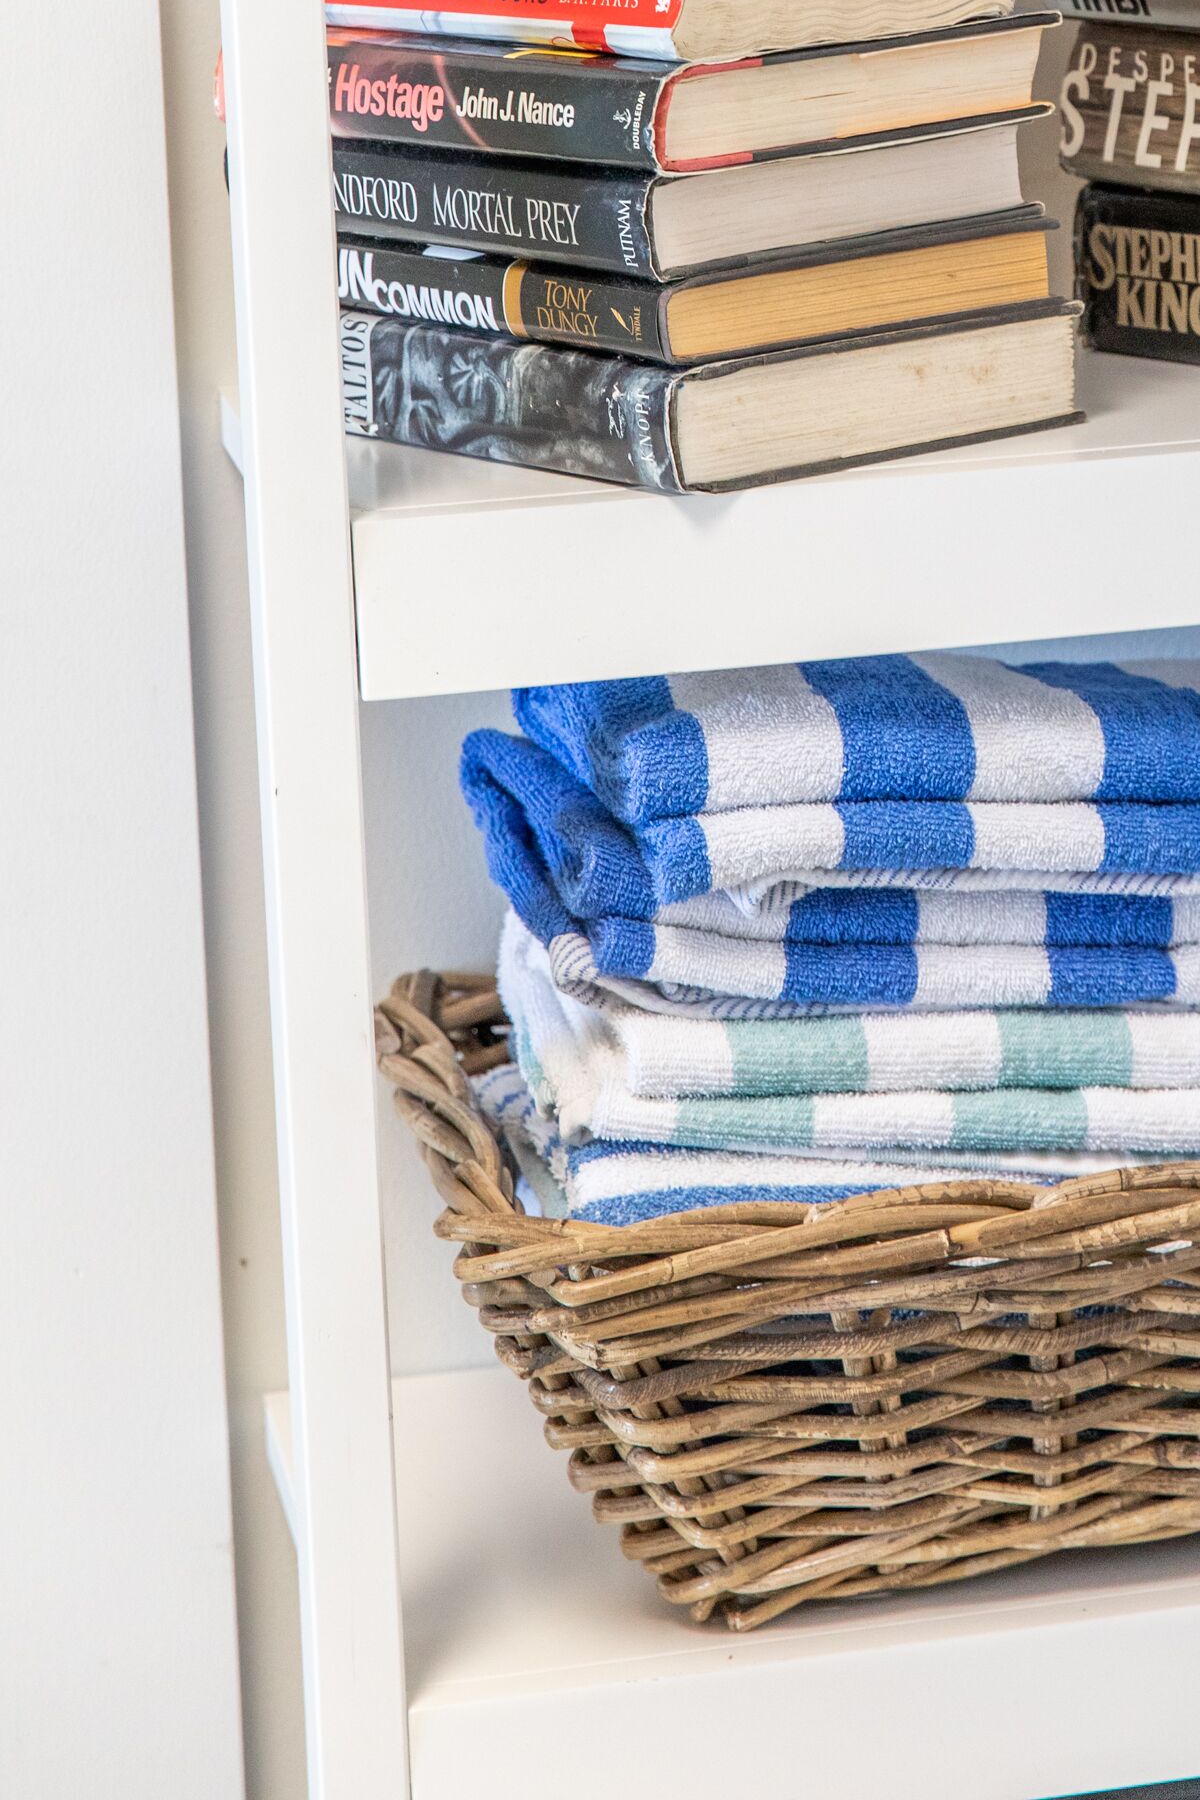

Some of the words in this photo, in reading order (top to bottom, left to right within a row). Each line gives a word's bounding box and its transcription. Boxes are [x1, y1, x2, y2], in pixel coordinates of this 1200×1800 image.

[335, 63, 444, 132] Hostage
[456, 86, 498, 121] John
[499, 90, 515, 122] J.
[518, 91, 575, 128] Nance
[632, 91, 647, 150] DOUBLEDAY
[433, 182, 521, 237] MORTAL
[526, 198, 580, 246] PREY
[617, 199, 639, 268] PUTNAM
[537, 306, 598, 337] DUNGY
[544, 280, 592, 313] TONY
[633, 306, 642, 341] TYNDALE
[341, 319, 369, 424] TALTOS
